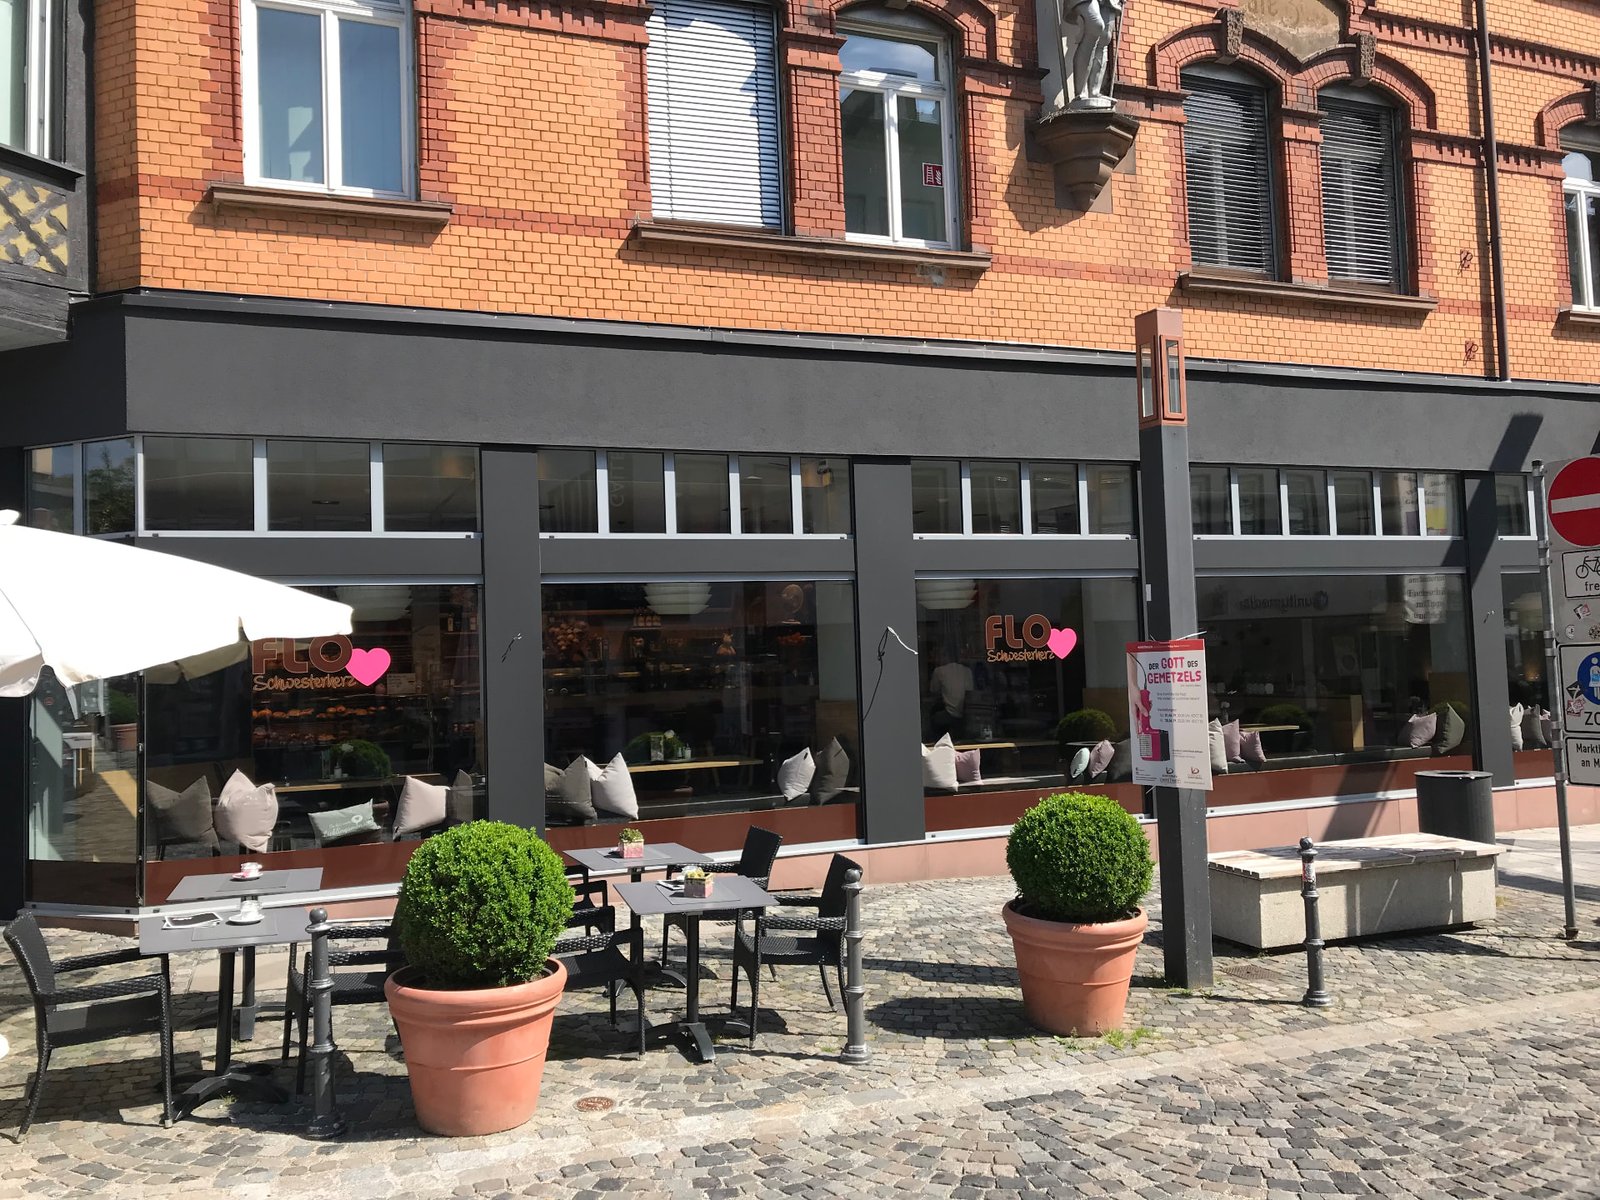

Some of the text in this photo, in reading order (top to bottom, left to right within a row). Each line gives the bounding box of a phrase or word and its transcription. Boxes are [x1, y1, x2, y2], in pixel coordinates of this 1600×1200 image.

[985, 613, 1052, 650] FLO
[251, 634, 353, 675] FLO
[987, 649, 1055, 663] Schwesterherz
[1148, 656, 1199, 670] DER GOTT DES
[252, 673, 357, 691] Schwesterherz
[1147, 670, 1202, 684] GEMETZELS
[1581, 759, 1591, 768] an
